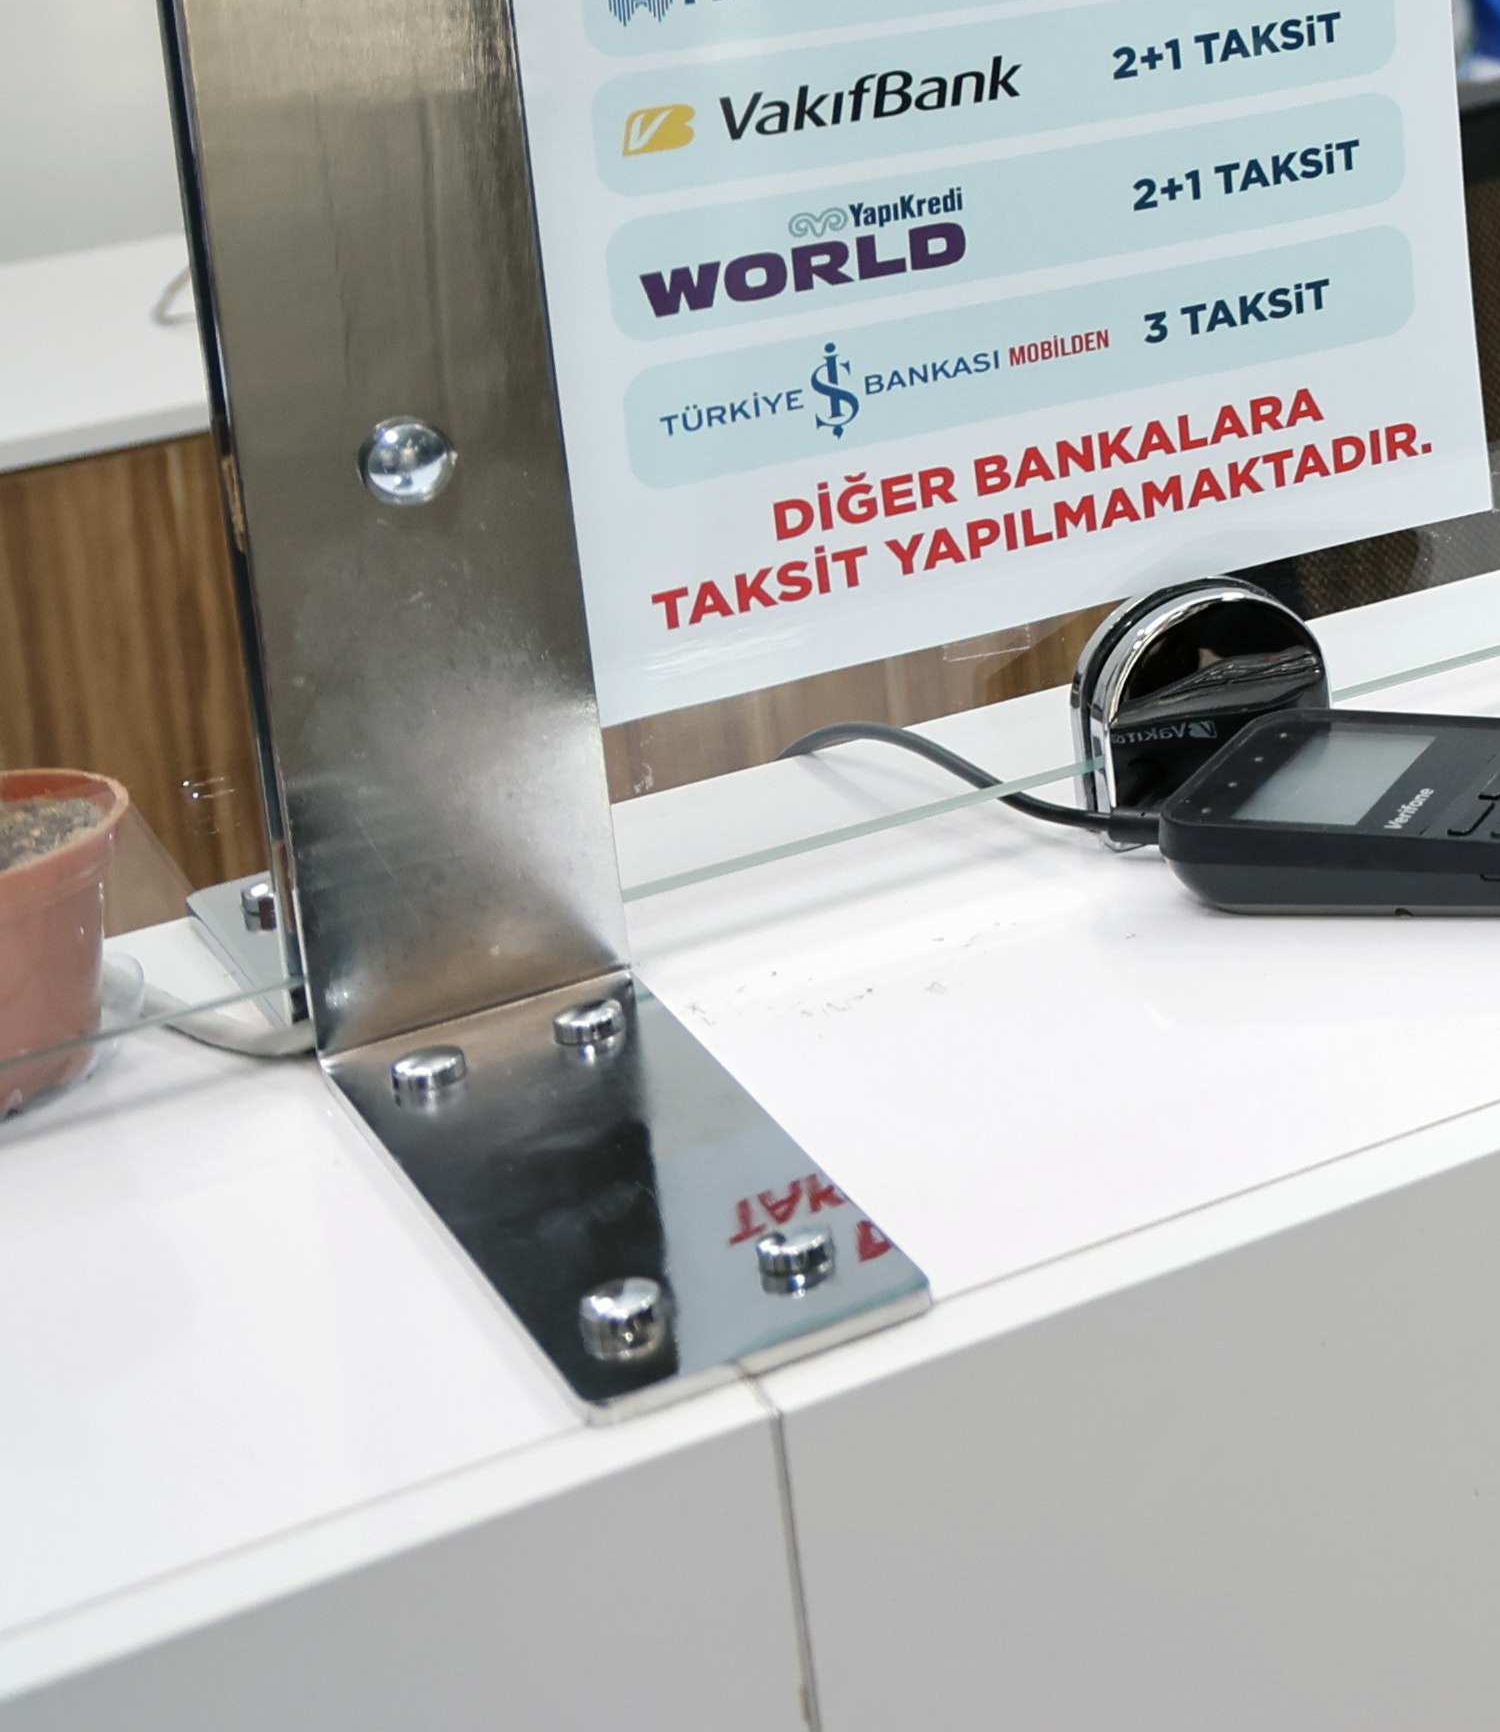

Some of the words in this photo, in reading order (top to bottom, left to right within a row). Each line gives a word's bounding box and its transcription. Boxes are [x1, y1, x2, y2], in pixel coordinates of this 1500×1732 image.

[1112, 38, 1182, 81] 2+1
[719, 55, 1022, 141] VakıfBank
[848, 186, 963, 228] YapıKredi
[1132, 169, 1202, 212] 2+1
[639, 221, 967, 318] WORLD
[1143, 310, 1168, 344] 3
[659, 388, 805, 437] TÜRKİYE
[864, 349, 1000, 396] BANKASI
[1008, 329, 1110, 367] MOBİLDEN
[772, 466, 958, 542] DİĞER
[973, 387, 1325, 497] BANKALARA
[651, 545, 868, 631] TAKSİT
[884, 422, 1433, 576] YAPILMAMAKTADIR.
[1384, 787, 1435, 830] Verifone
